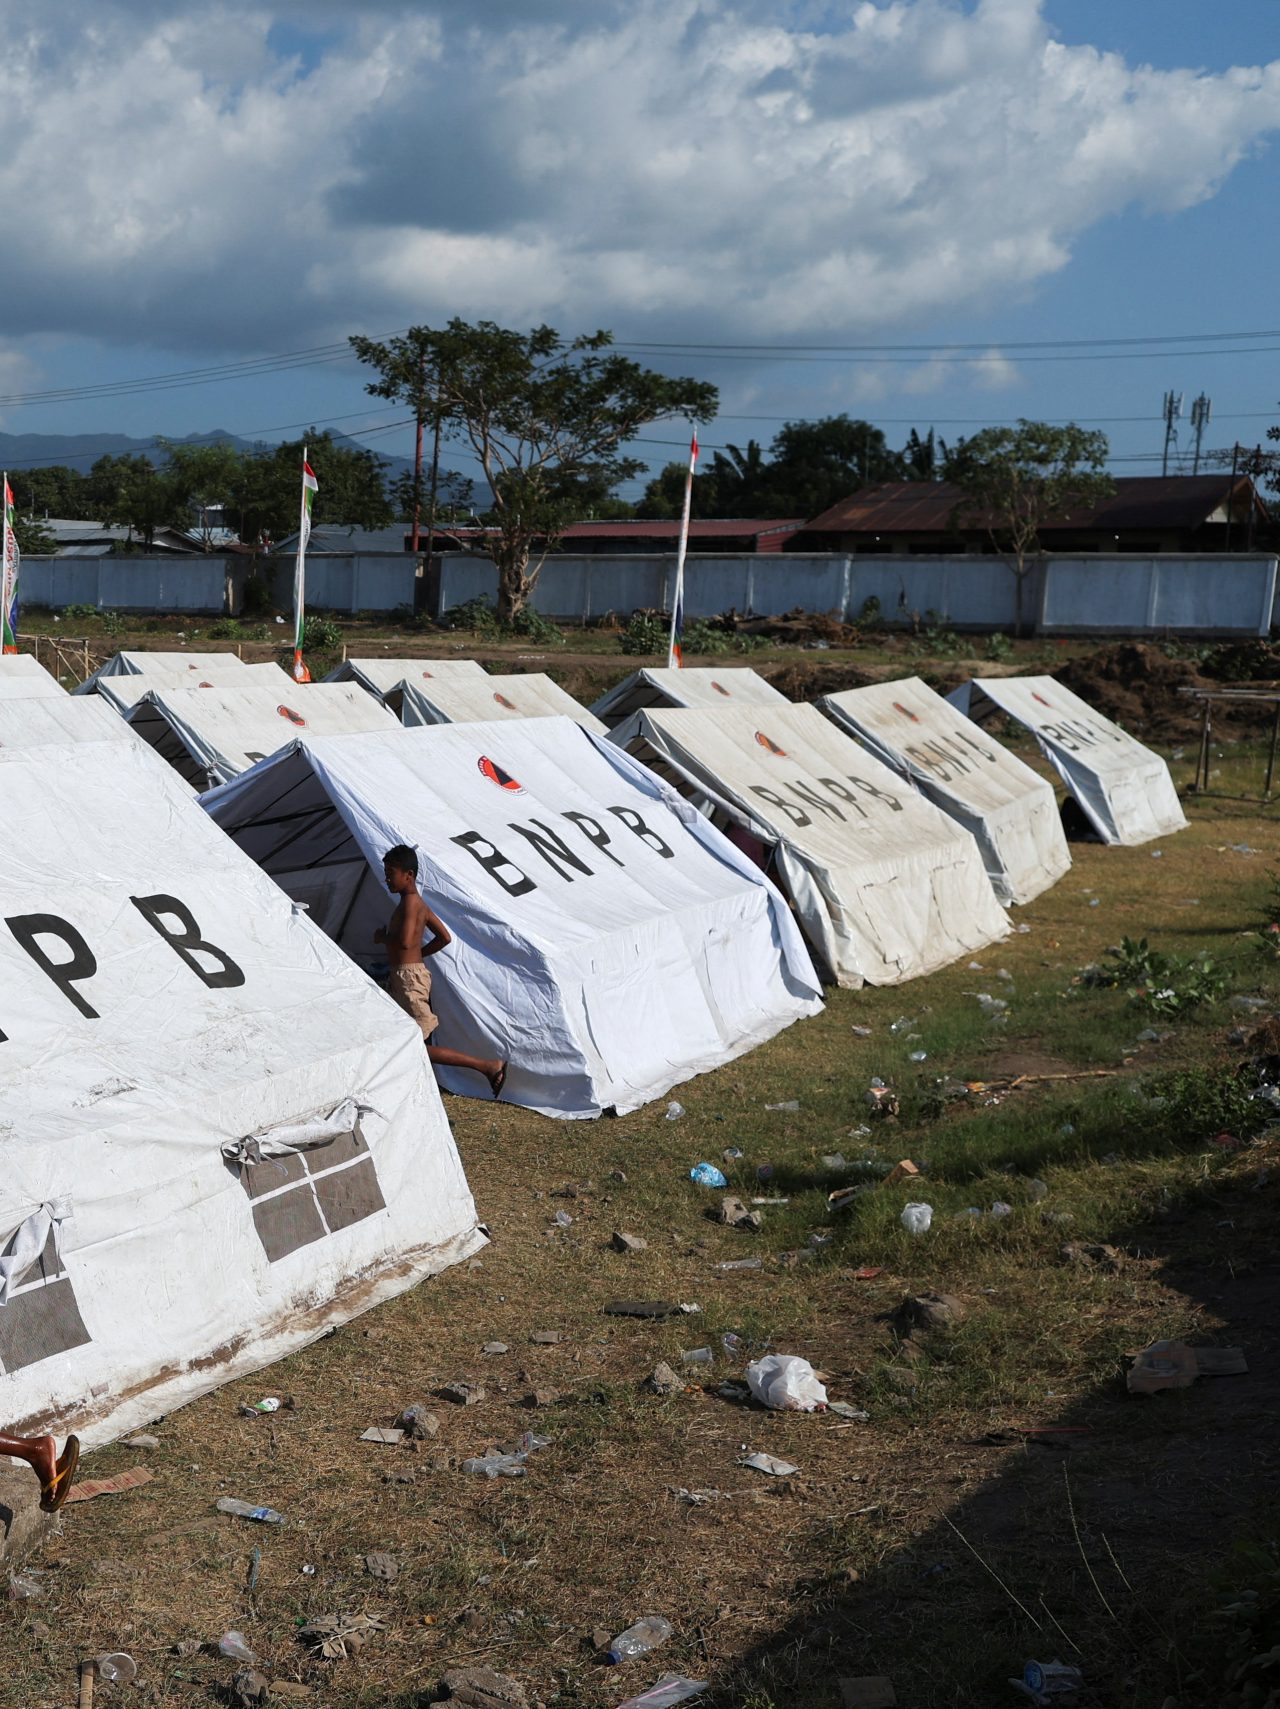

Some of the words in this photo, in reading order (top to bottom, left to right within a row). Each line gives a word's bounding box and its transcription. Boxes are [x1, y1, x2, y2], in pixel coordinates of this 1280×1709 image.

[6, 527, 14, 562] NUSA
[748, 776, 903, 828] BNPB
[449, 806, 675, 897] BNPB
